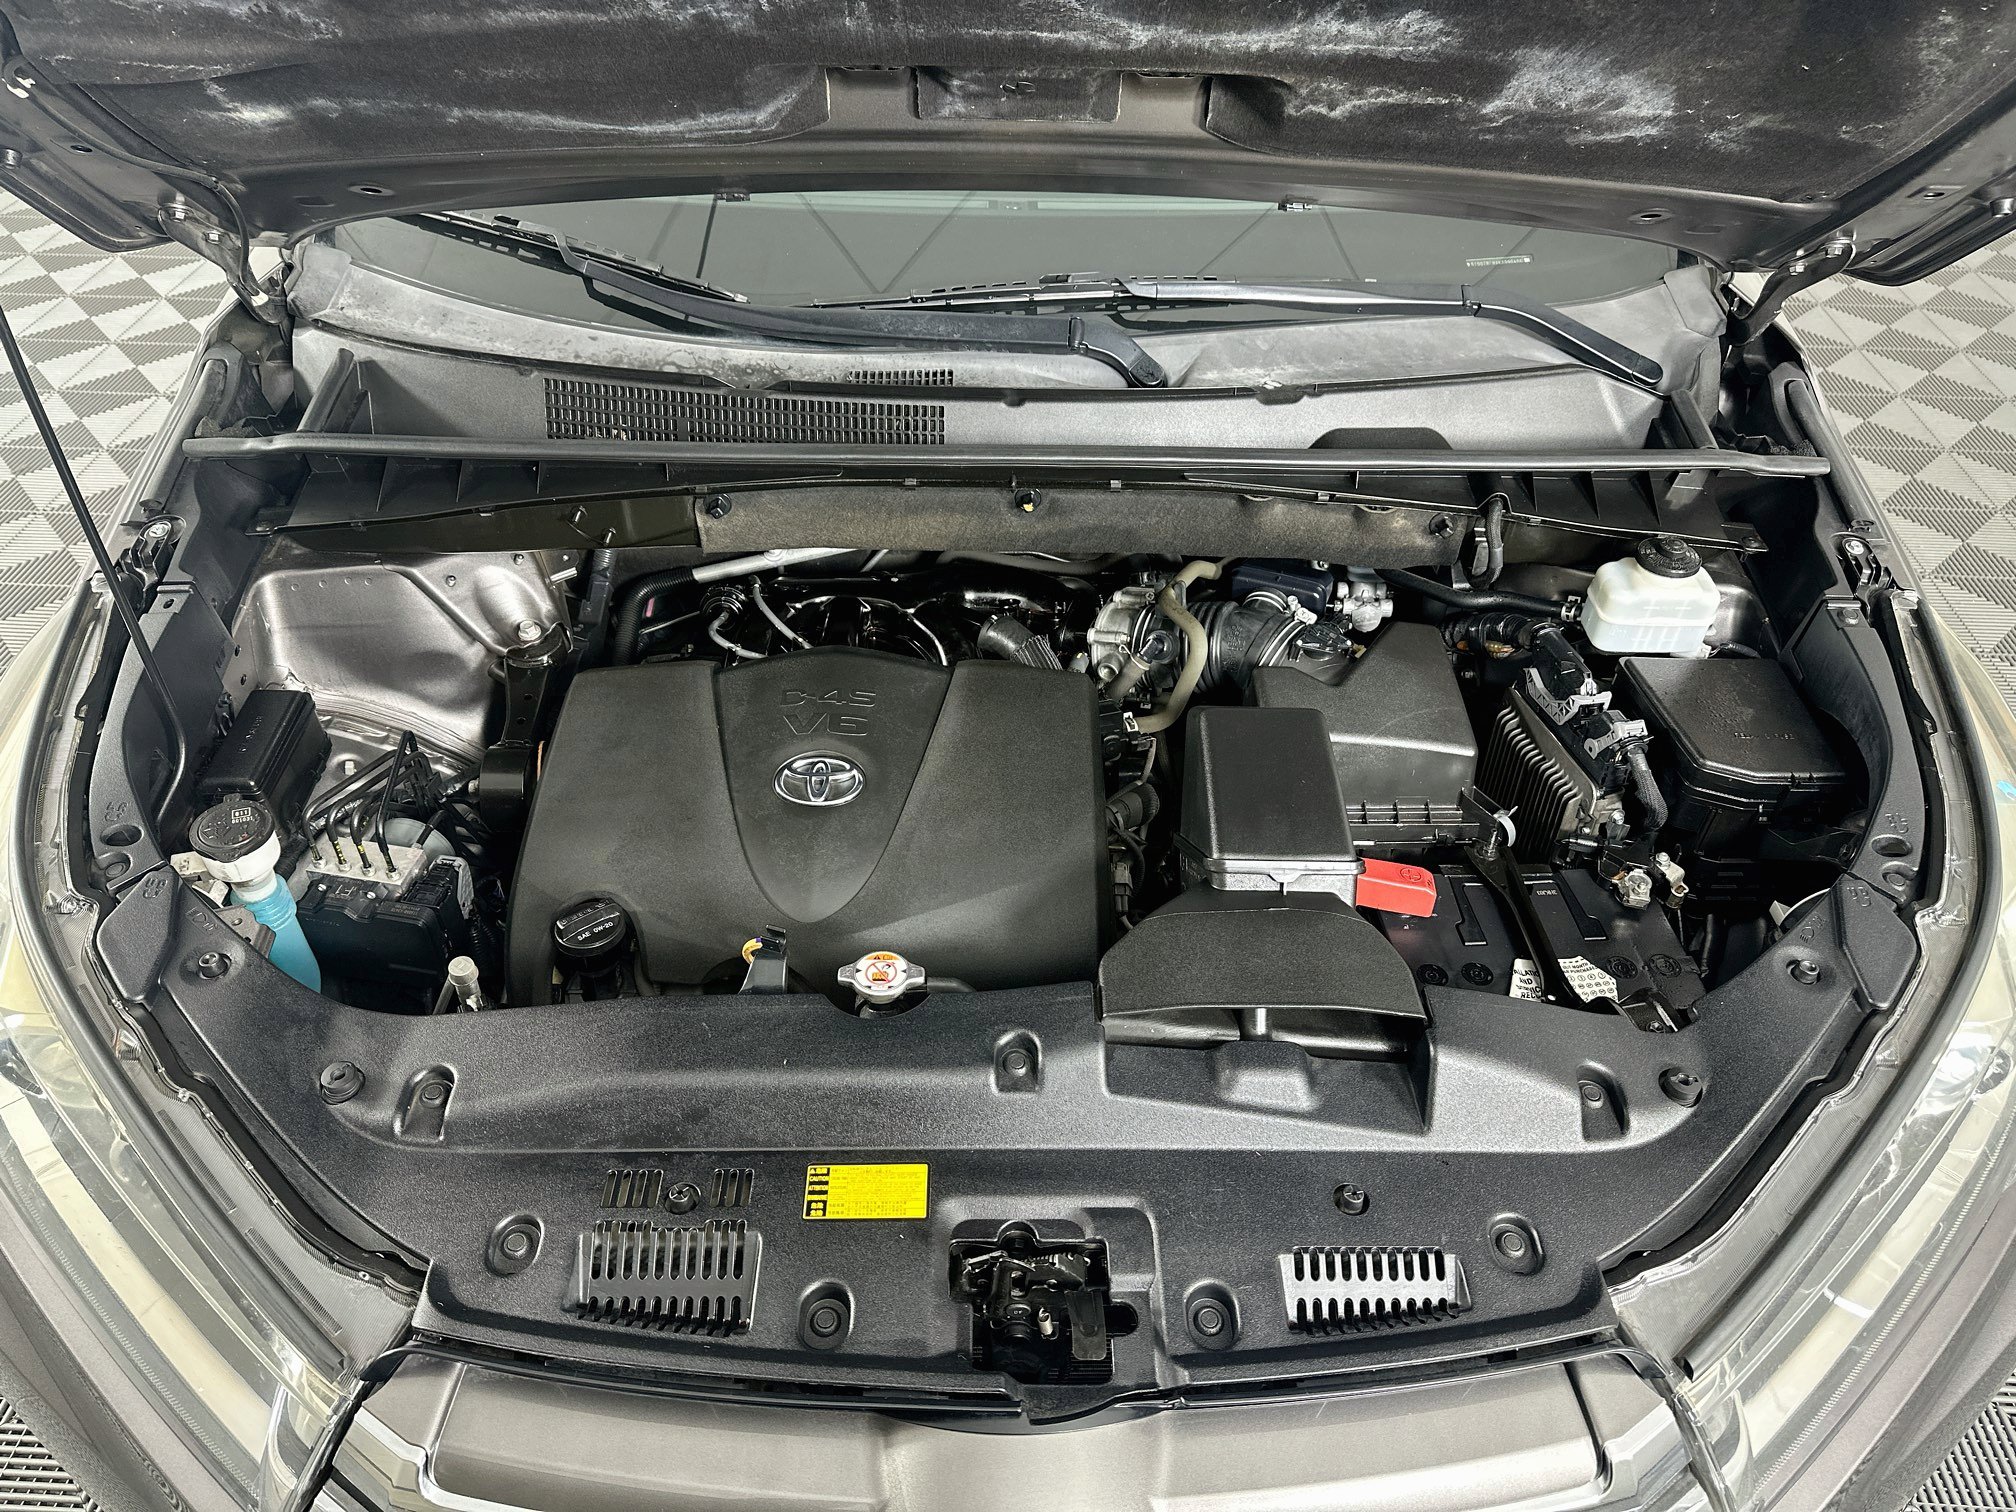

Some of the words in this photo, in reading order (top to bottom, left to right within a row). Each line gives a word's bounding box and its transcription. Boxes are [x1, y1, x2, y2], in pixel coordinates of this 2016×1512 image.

[780, 690, 877, 708] D-4S
[782, 712, 869, 736] V6
[577, 931, 592, 941] SAE
[593, 921, 614, 933] 0W-20
